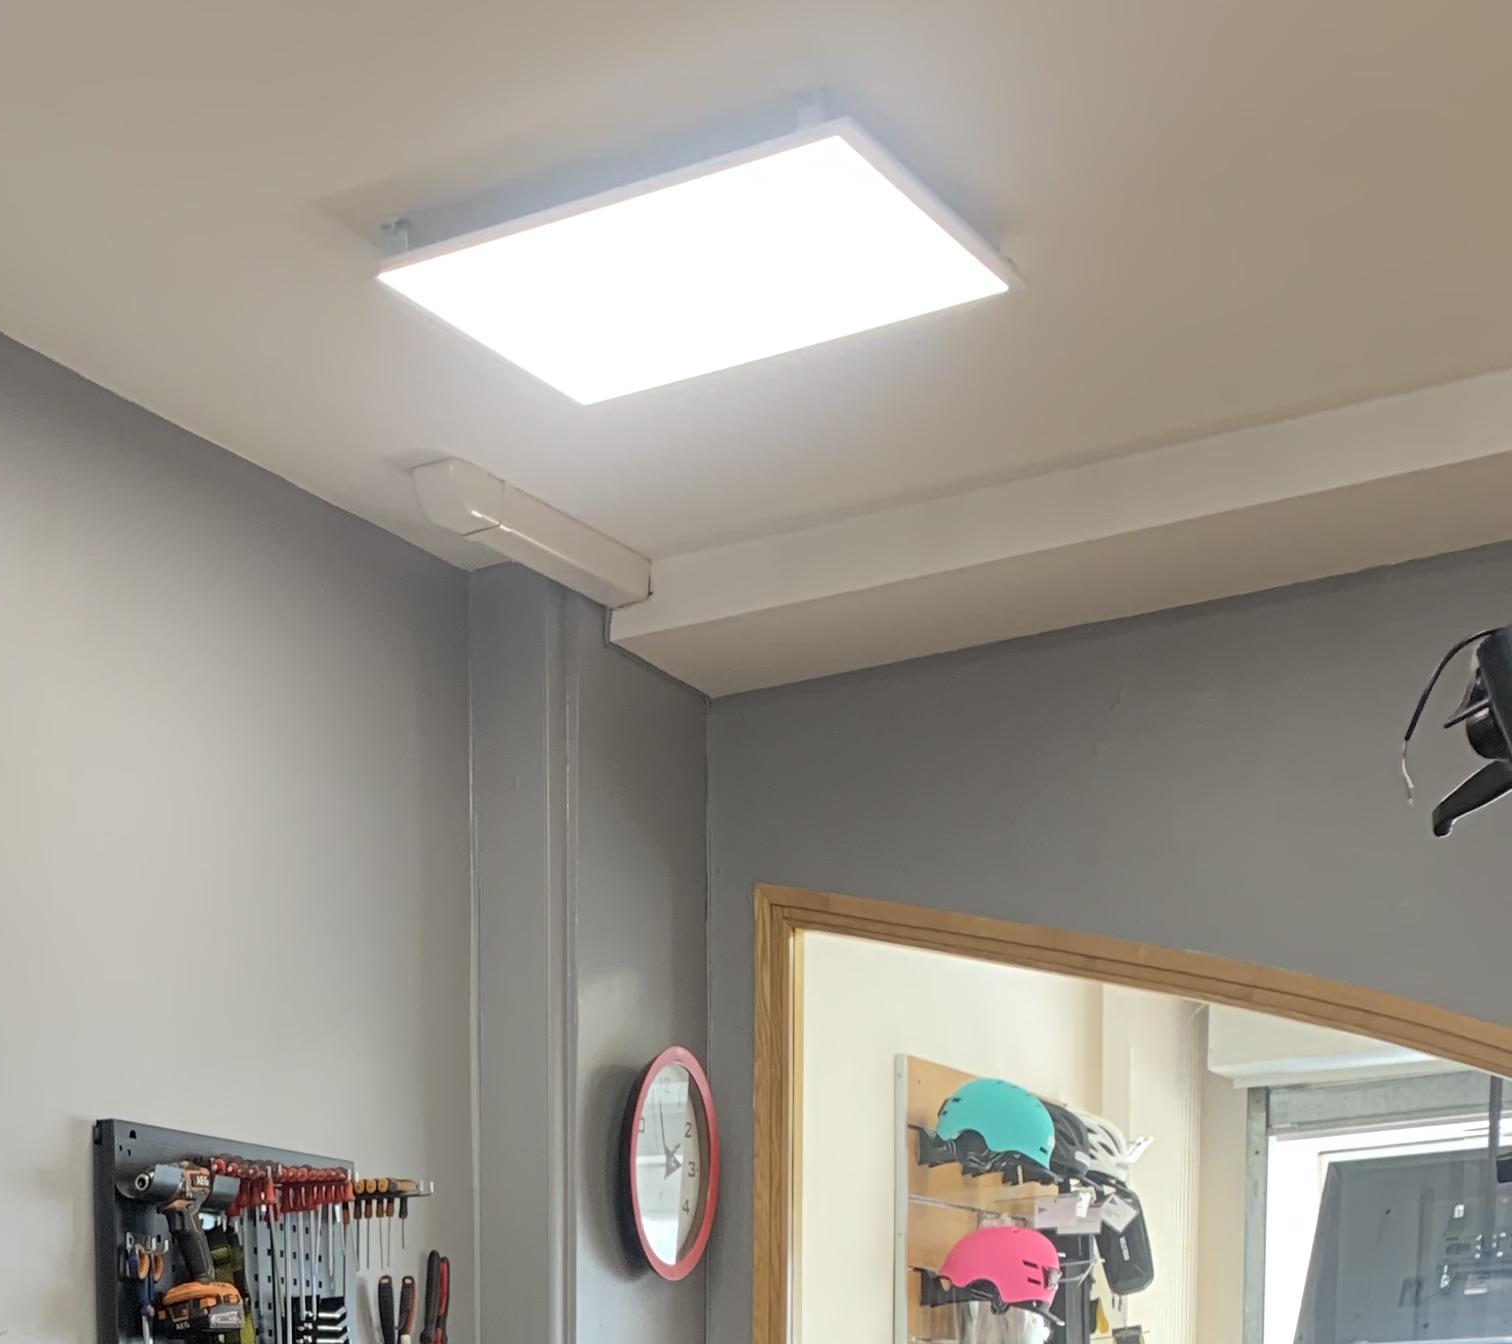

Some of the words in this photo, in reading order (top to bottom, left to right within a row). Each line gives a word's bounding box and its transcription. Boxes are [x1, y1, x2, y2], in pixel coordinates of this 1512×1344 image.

[685, 1122, 692, 1138] 2
[688, 1162, 696, 1177] 3
[196, 1175, 209, 1186] AEG
[682, 1199, 690, 1214] 4
